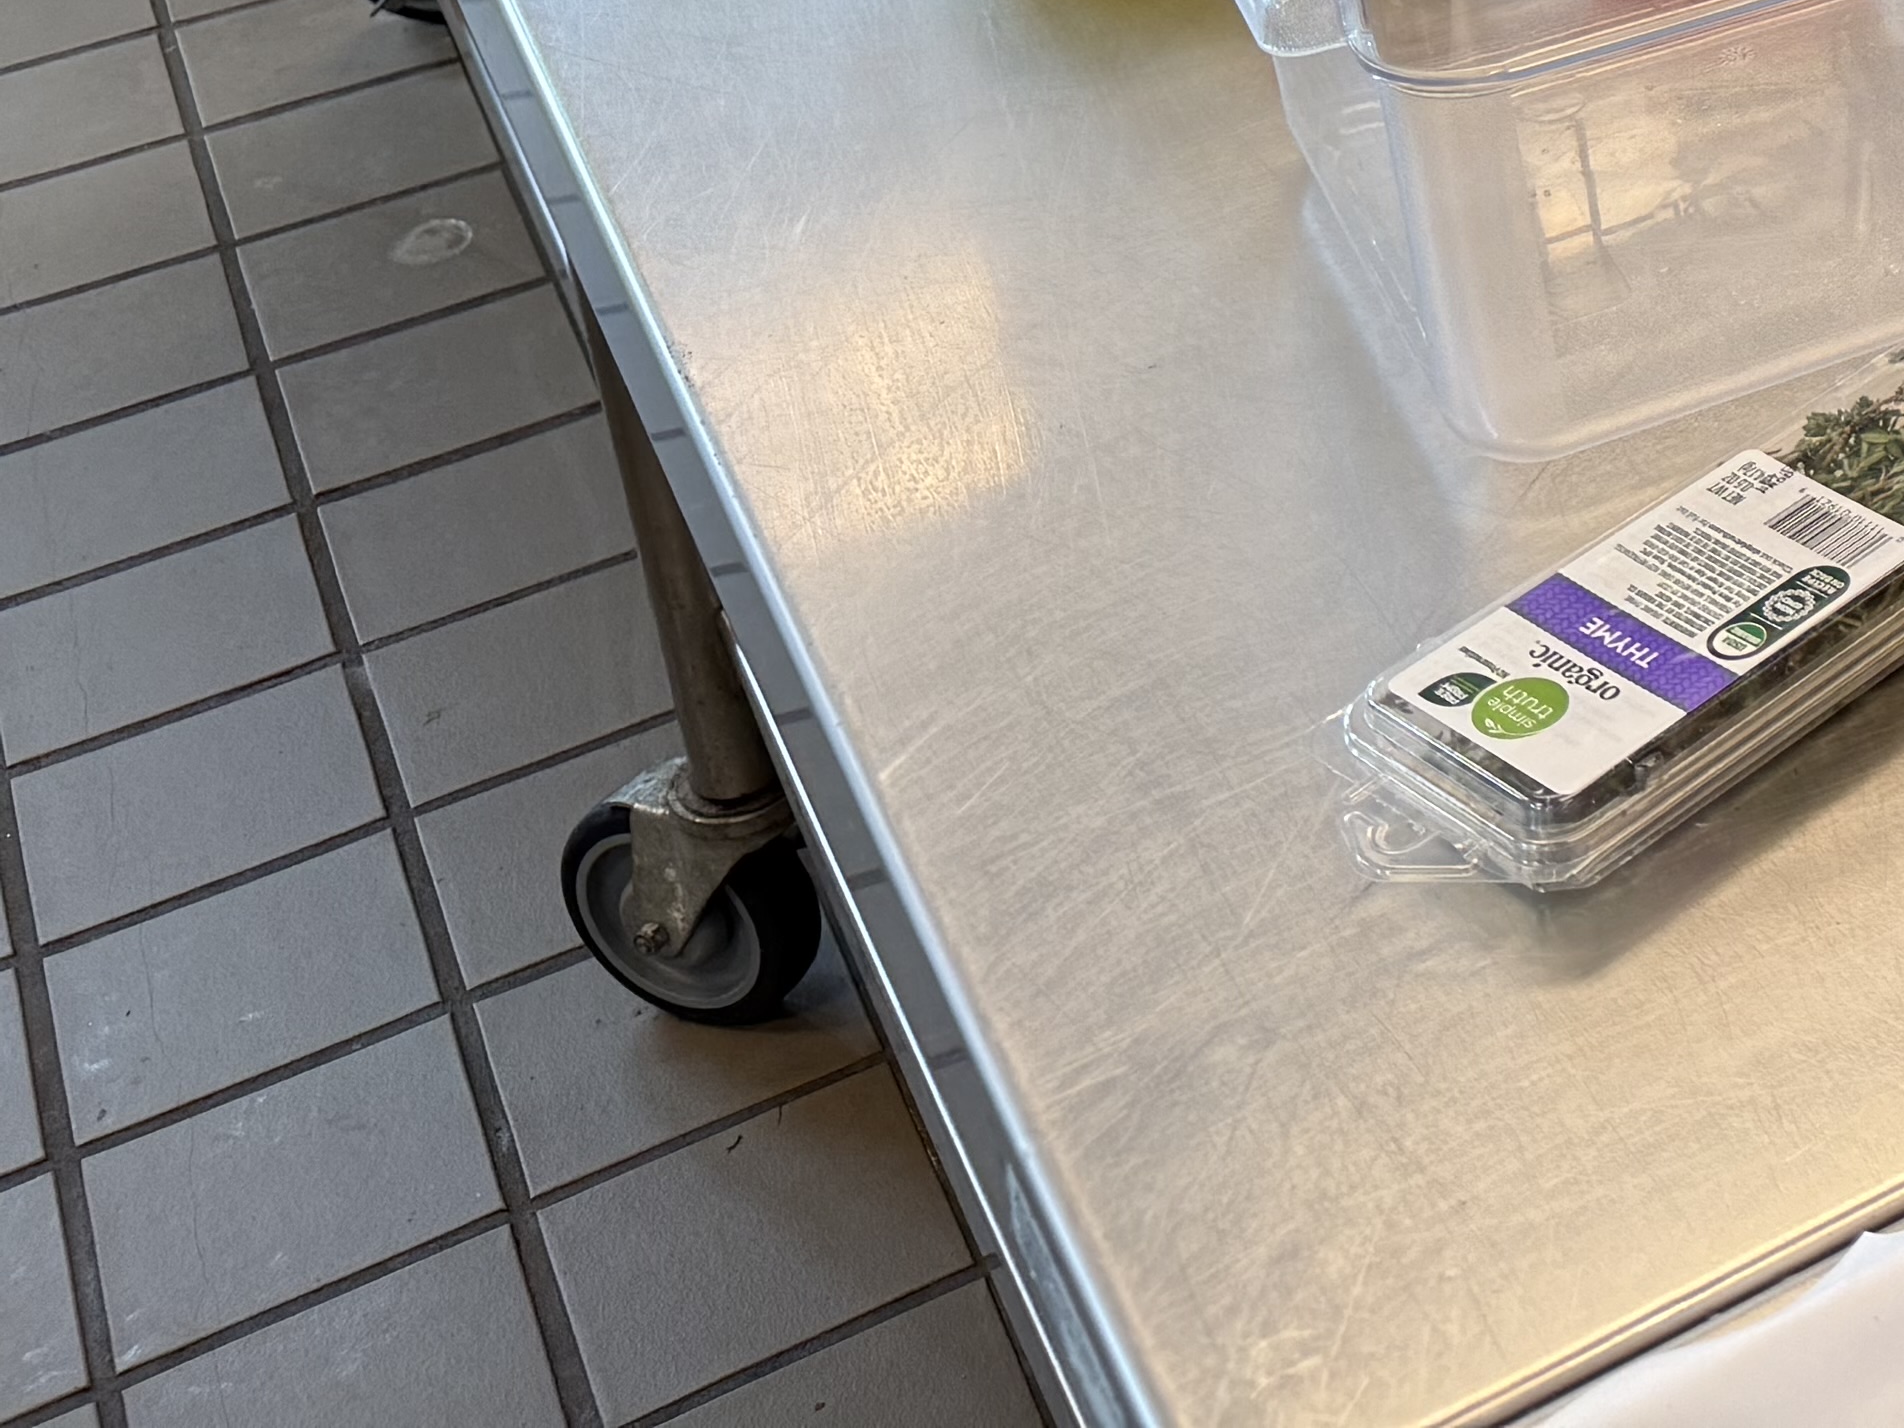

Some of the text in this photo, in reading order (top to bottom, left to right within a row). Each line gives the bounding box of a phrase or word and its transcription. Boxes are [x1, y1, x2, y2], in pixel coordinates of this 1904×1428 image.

[1580, 617, 1659, 670] THYME
[1529, 644, 1620, 703] organic
[1486, 695, 1538, 729] simple
[1502, 685, 1554, 720] truth
